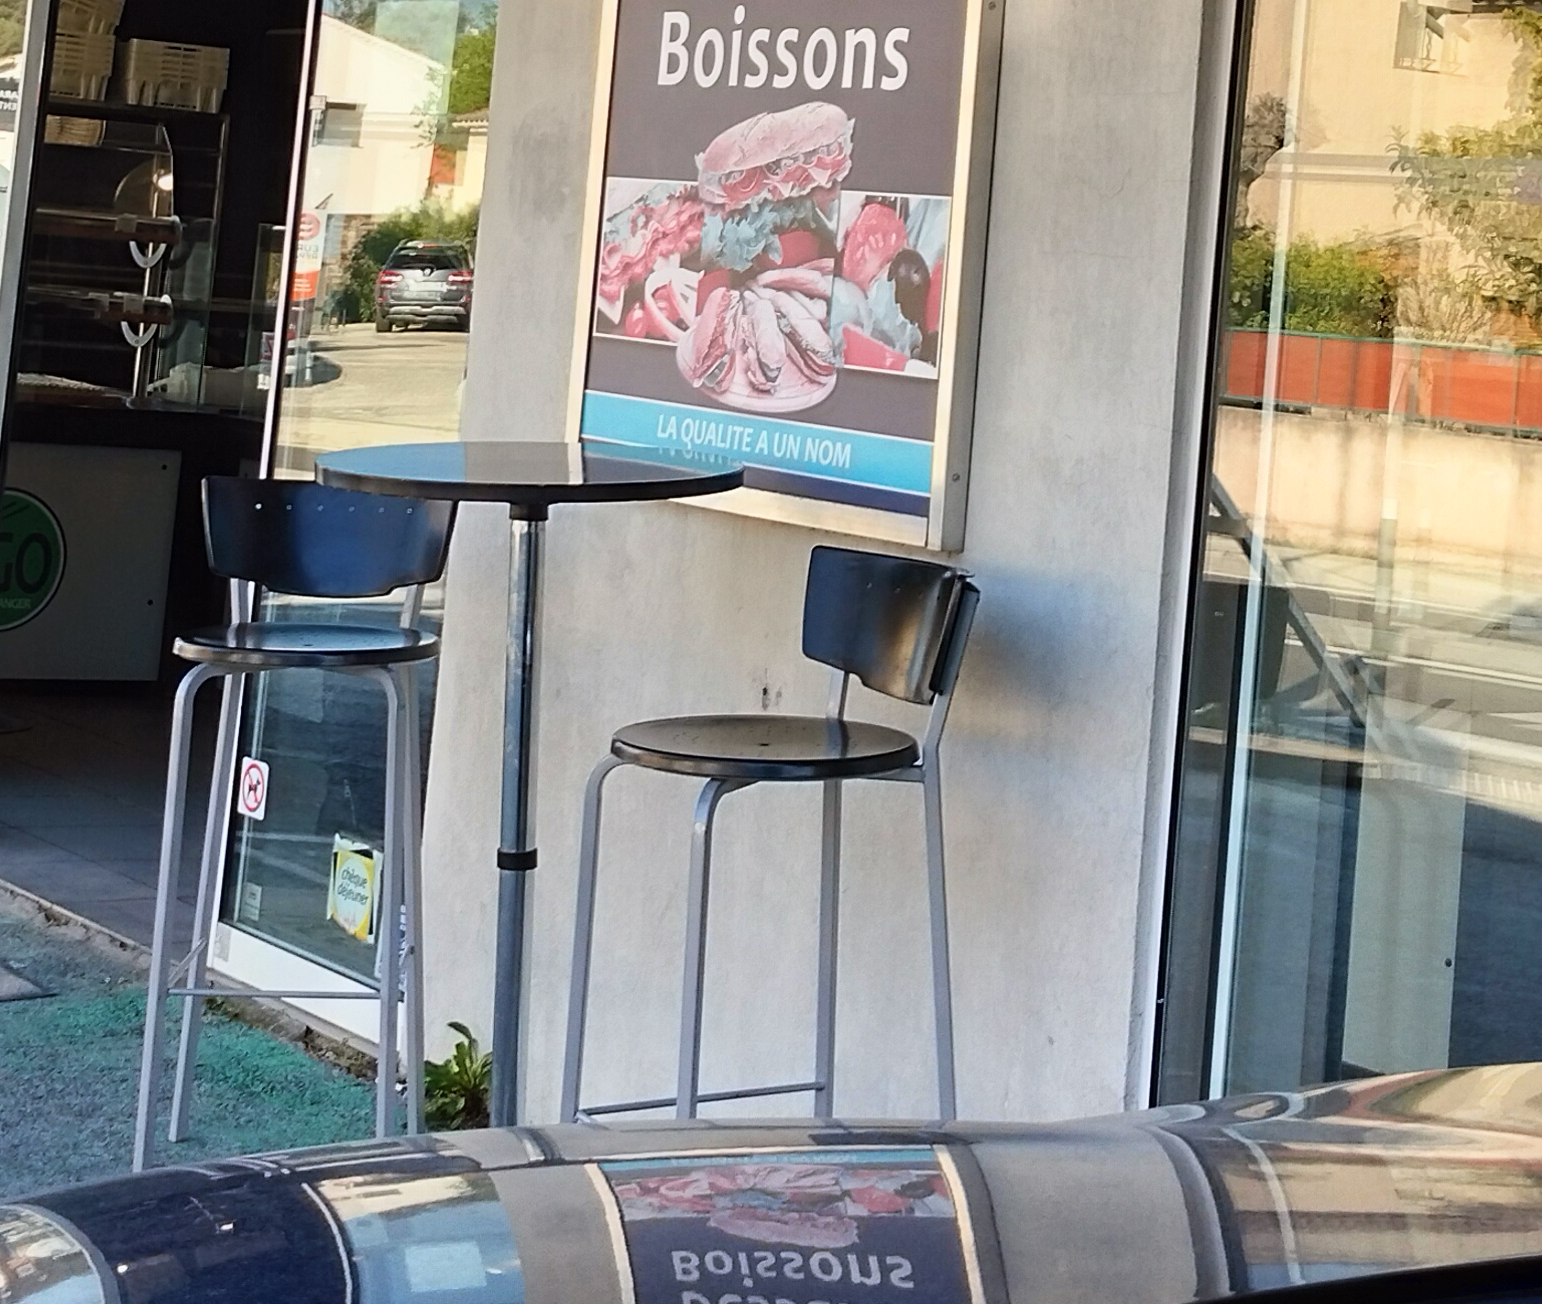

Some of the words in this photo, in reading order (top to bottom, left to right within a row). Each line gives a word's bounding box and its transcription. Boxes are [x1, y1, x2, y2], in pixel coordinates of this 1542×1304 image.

[658, 4, 911, 91] Boissons
[657, 414, 677, 440] LA
[680, 418, 753, 452] QUALITE
[755, 429, 768, 456] A
[773, 432, 801, 460] UN
[804, 437, 851, 469] NOM
